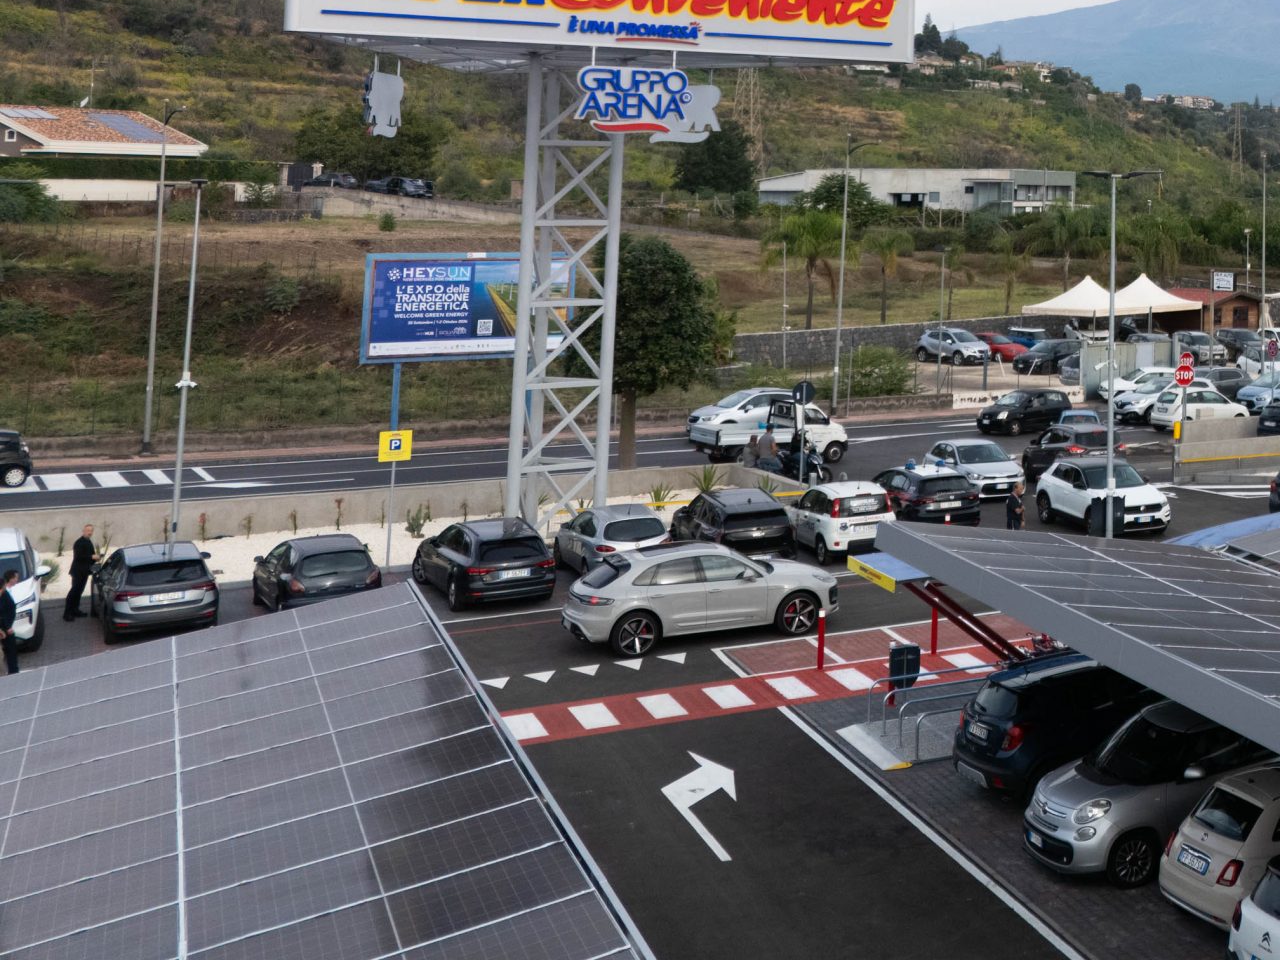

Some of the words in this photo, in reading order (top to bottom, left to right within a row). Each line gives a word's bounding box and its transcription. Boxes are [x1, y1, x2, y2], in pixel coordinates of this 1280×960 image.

[580, 19, 614, 34] UNA
[616, 22, 698, 39] PROMESSA
[580, 68, 688, 94] GRUPPO
[579, 91, 685, 120] ARENA
[446, 284, 470, 293] della
[396, 293, 469, 302] TRANSIZIONE
[395, 302, 468, 312] ENERGETICA
[1175, 371, 1194, 380] STOP
[391, 440, 400, 450] P
